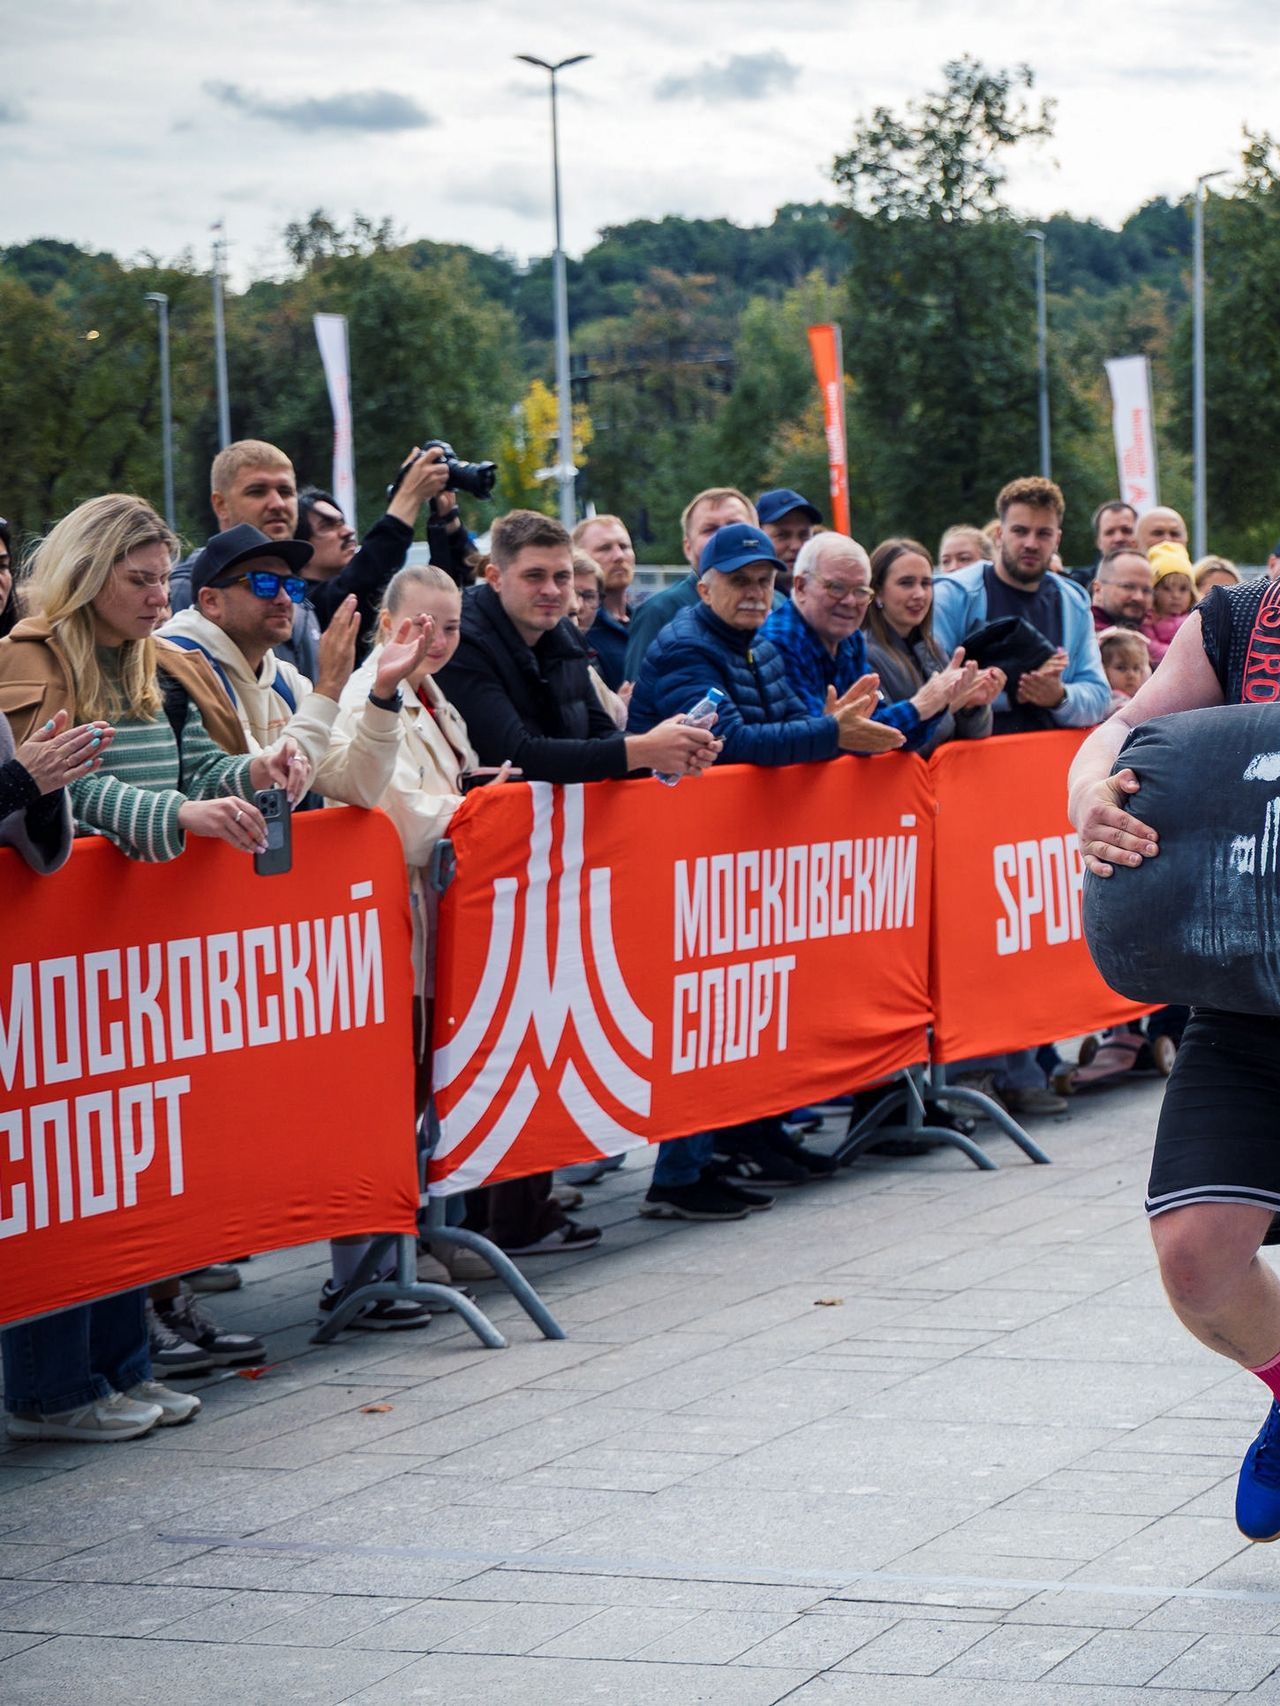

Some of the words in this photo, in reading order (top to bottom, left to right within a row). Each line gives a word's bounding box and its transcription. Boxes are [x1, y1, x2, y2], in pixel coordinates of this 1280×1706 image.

[674, 814, 918, 962] МОСКОВСКИЙ
[671, 955, 796, 1075] СПОРТ
[0, 1075, 191, 1240] СПОРТ
